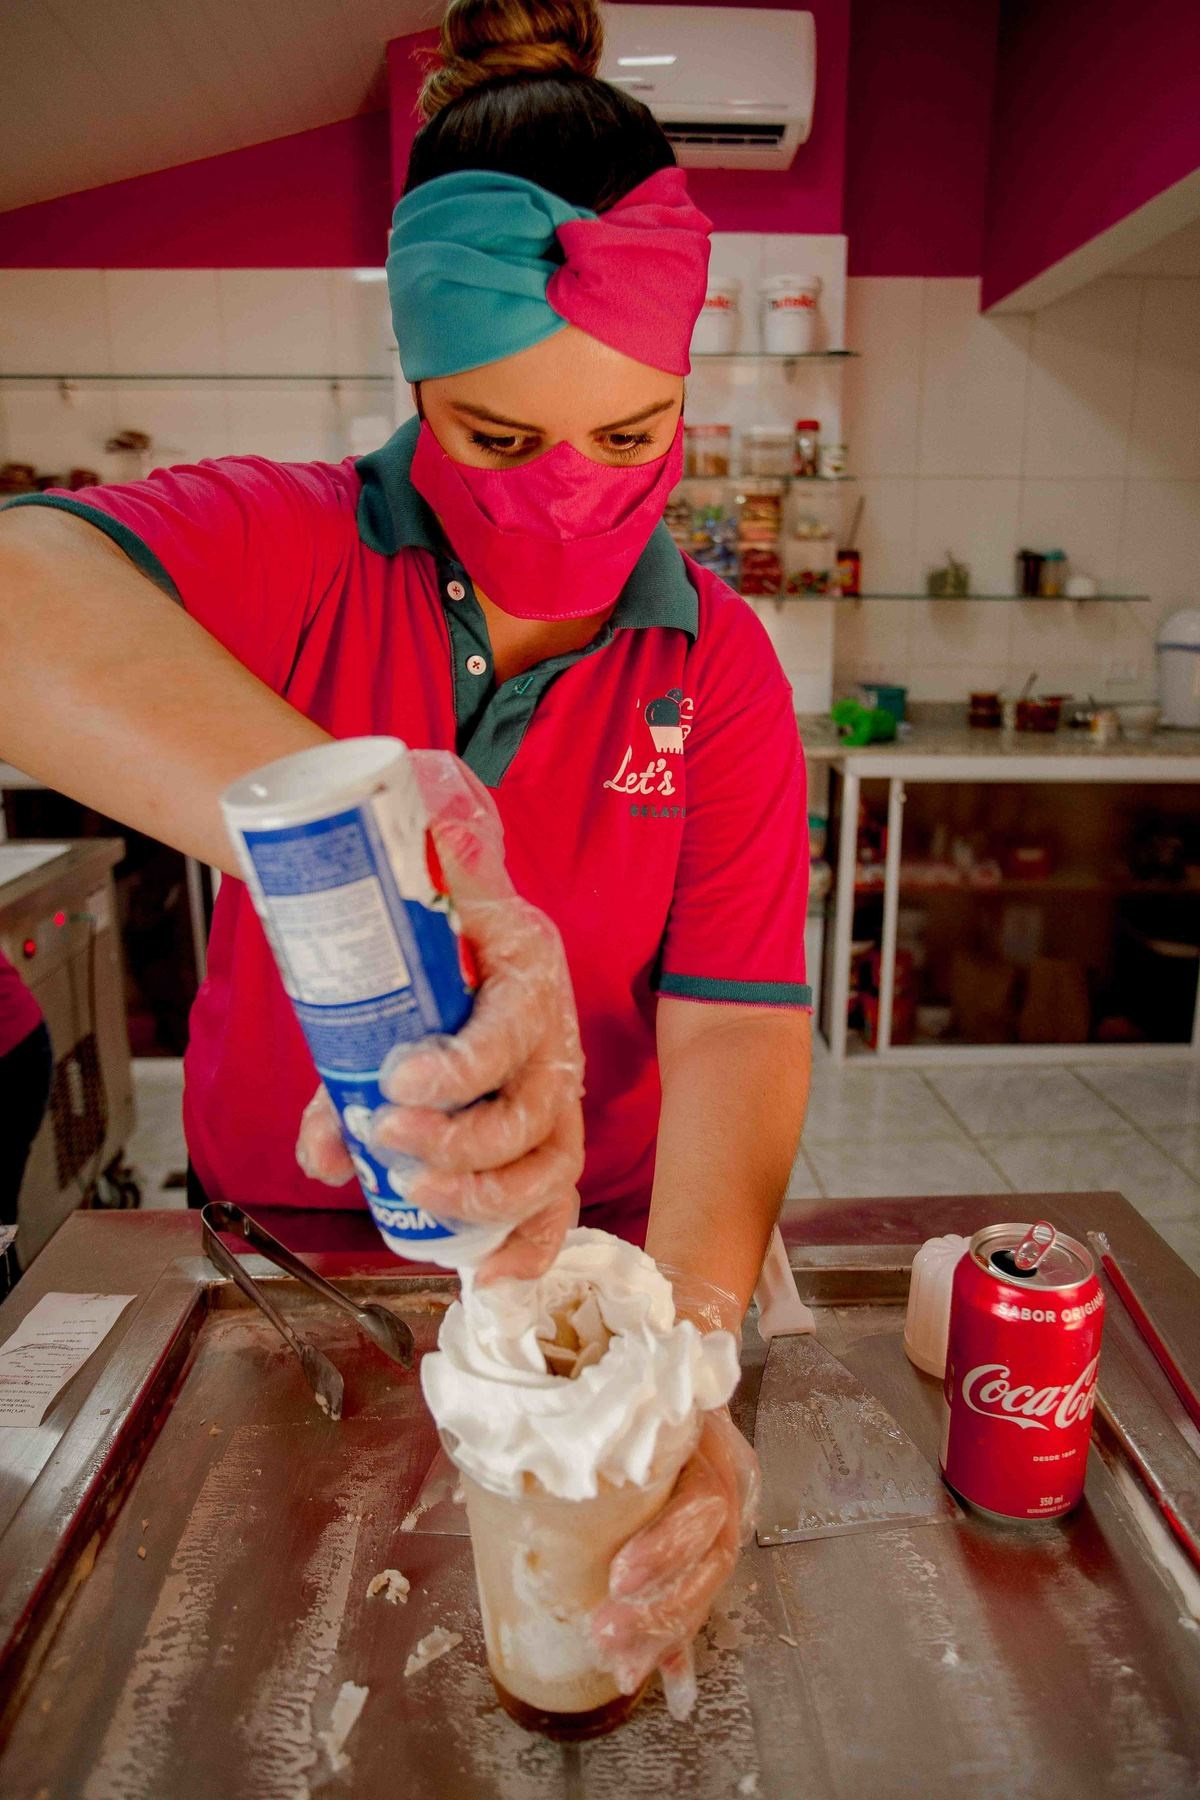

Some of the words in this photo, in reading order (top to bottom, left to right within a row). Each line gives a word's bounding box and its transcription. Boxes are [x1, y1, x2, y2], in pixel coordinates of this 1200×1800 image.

[603, 745, 676, 796] Let's
[998, 1301, 1057, 1323] SABOR
[1032, 1454, 1060, 1462] DESDE
[1040, 1496, 1054, 1507] 350
